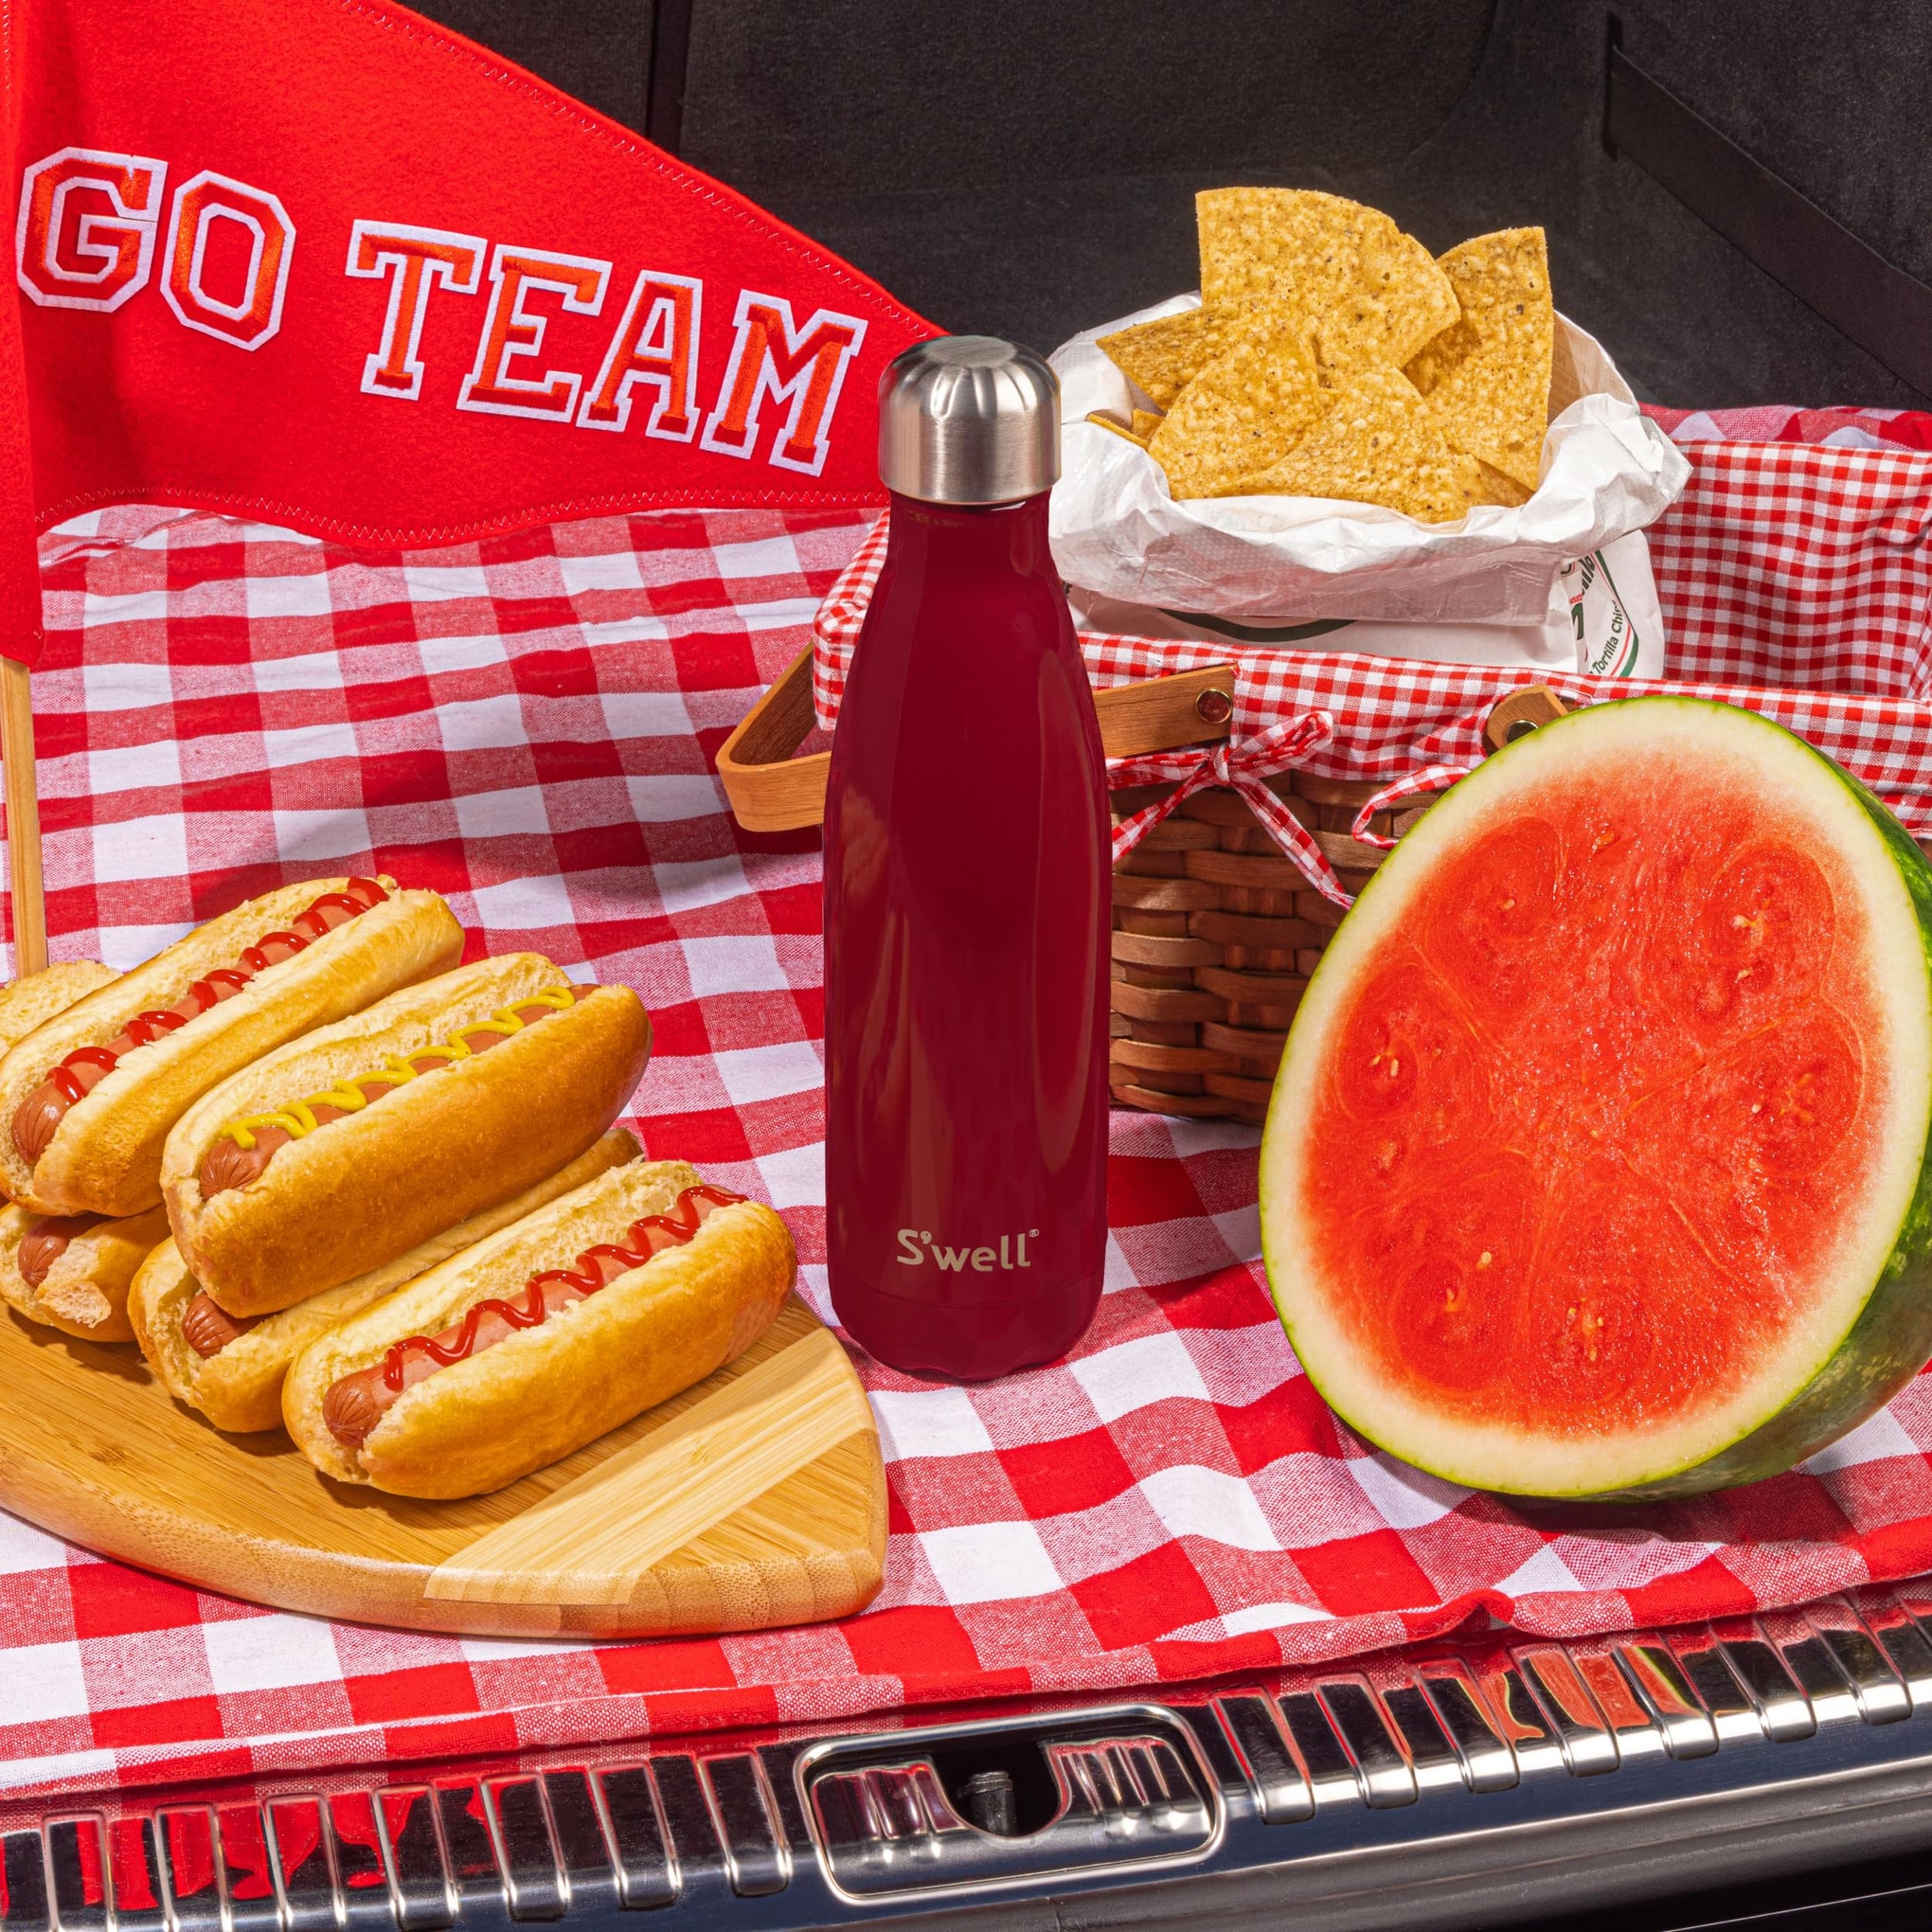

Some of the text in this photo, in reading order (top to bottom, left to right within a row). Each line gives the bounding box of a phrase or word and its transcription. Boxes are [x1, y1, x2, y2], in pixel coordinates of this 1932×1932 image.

[16, 146, 869, 477] GO TEAM
[1592, 636, 1619, 674] Tortilla
